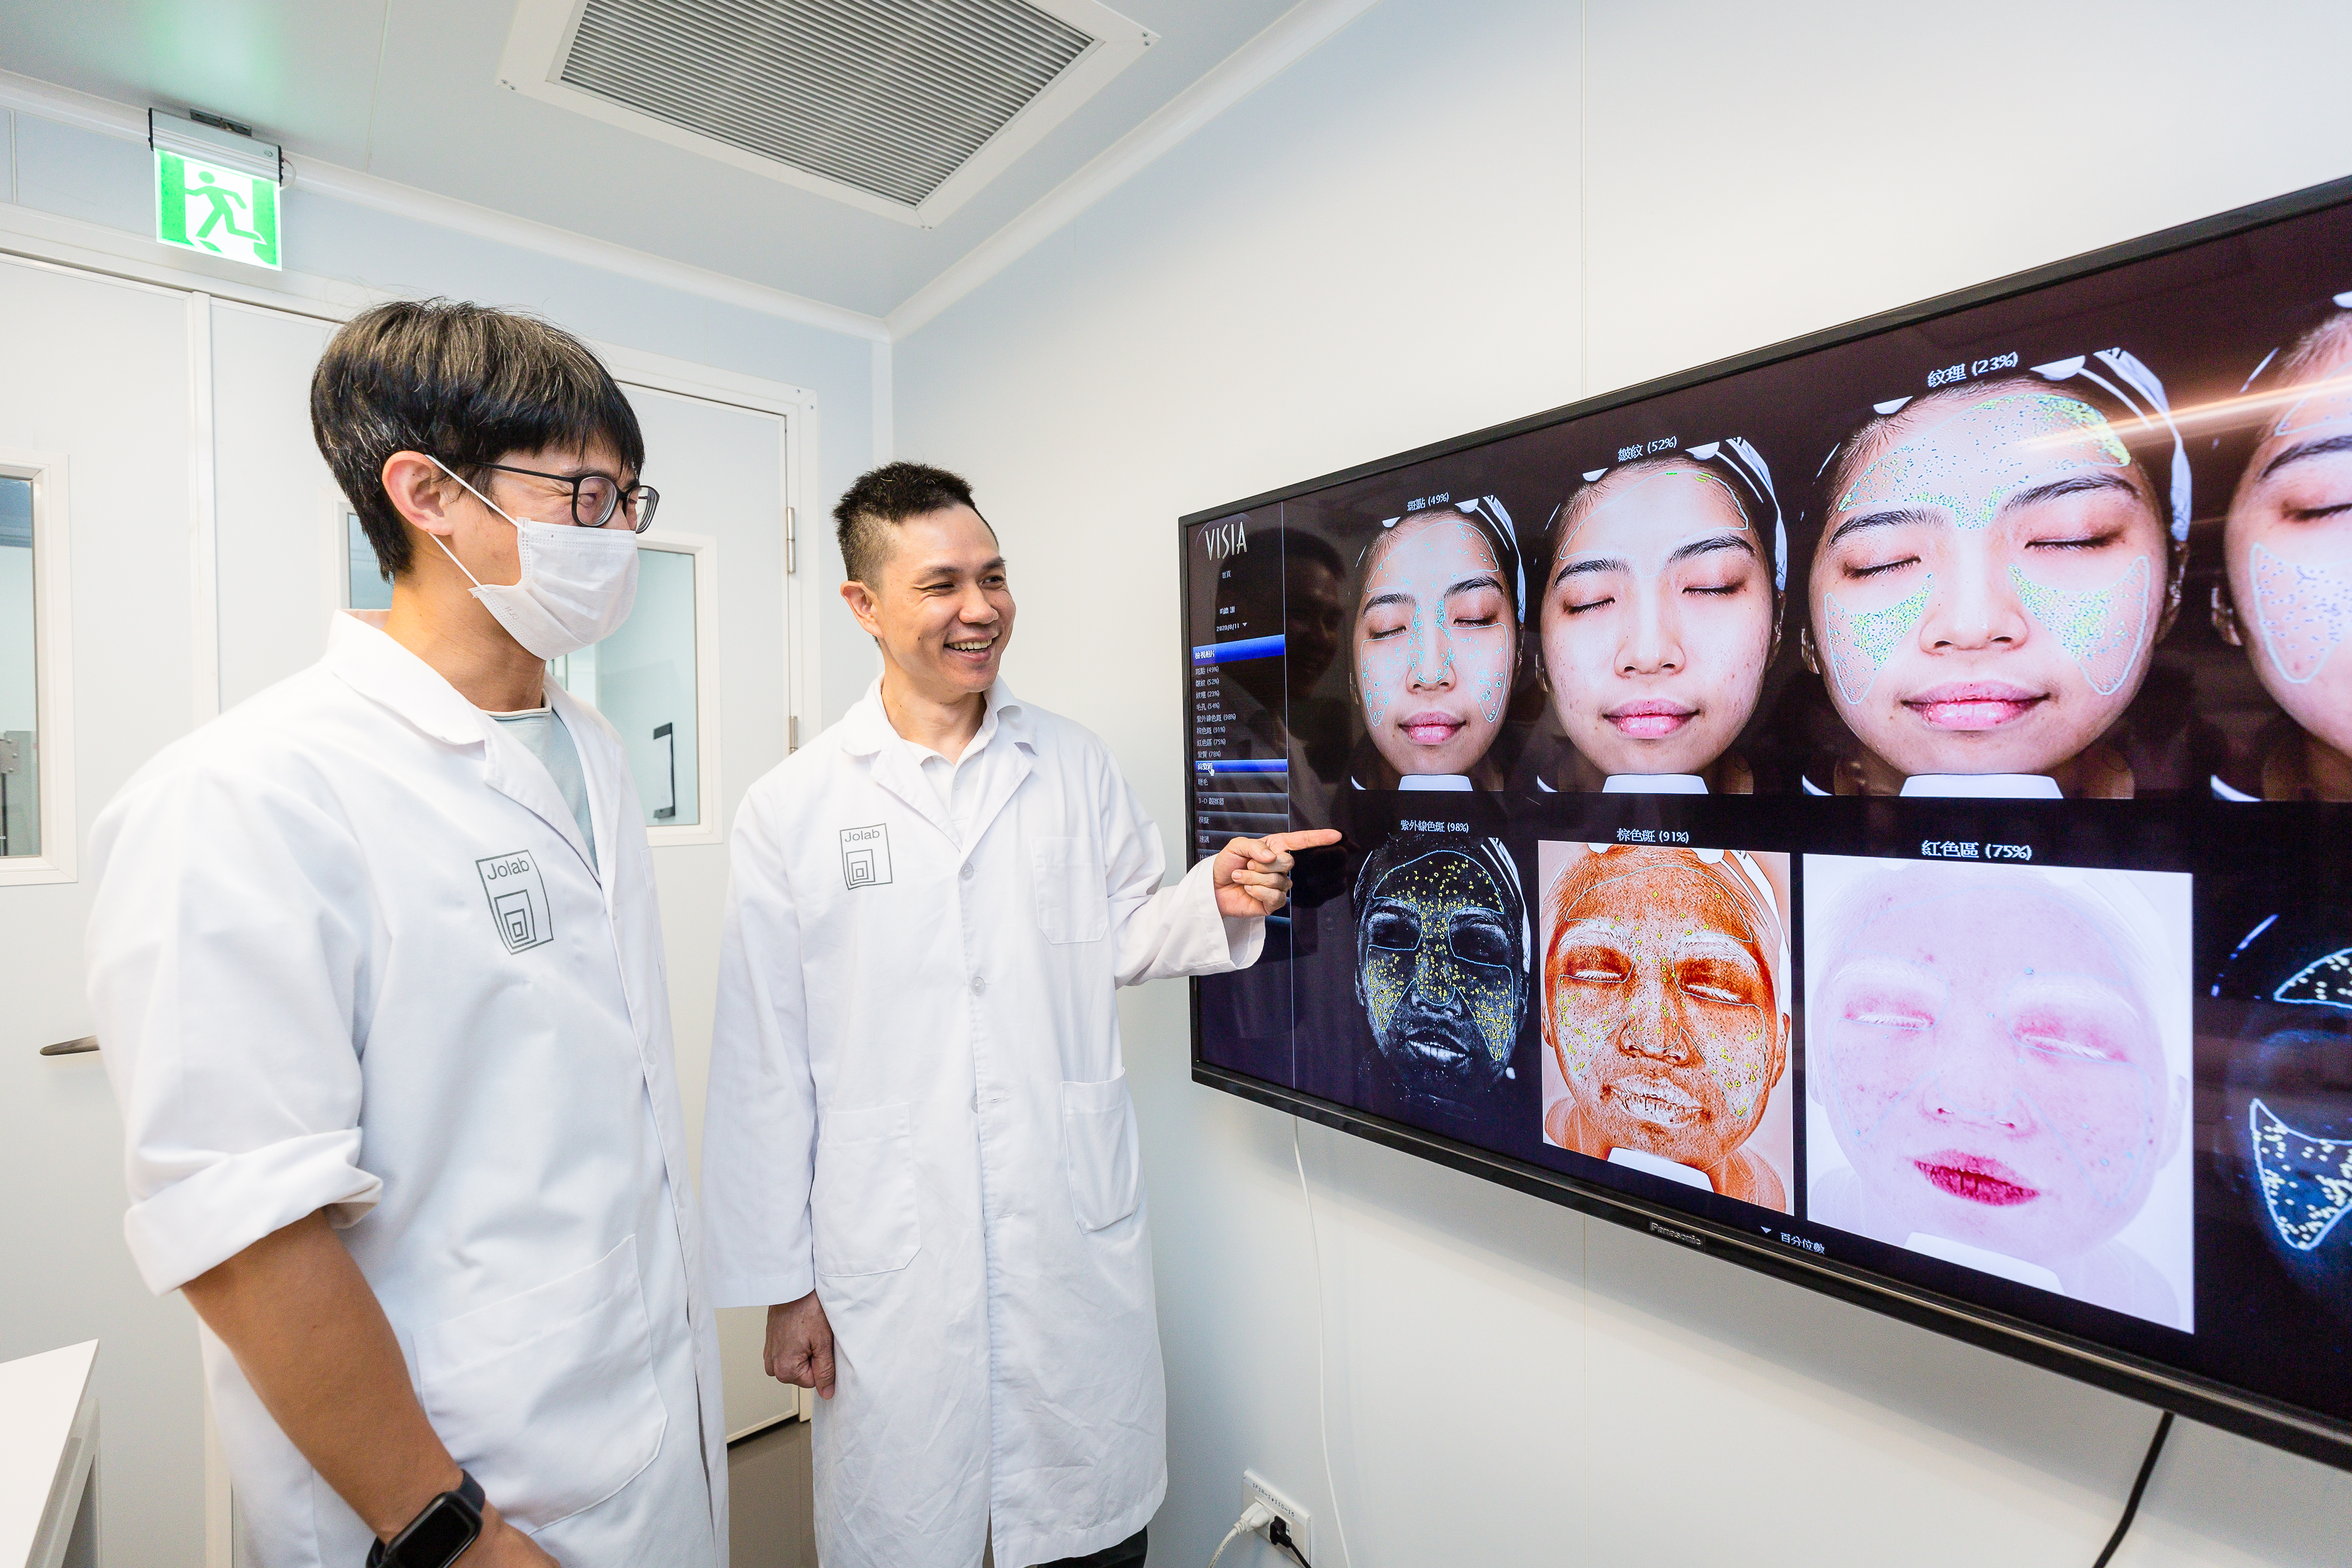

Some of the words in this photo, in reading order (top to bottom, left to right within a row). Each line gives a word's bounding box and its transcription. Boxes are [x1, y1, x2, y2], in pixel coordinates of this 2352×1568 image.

[1927, 363, 1967, 387] 紋理
[1971, 351, 2018, 376] (23%)
[1647, 435, 1677, 454] (52%)
[1407, 497, 1425, 511] 斑點
[1428, 492, 1449, 506] (49%)
[1205, 522, 1247, 560] VISIA
[1217, 623, 1239, 631] 2020/8/11
[1195, 650, 1214, 659] 檢視相片
[1197, 715, 1222, 723] 紫外線色斑
[845, 829, 880, 842] Jolab
[1401, 820, 1445, 832] 紫外線色斑
[1447, 822, 1469, 833] (98%)
[1617, 828, 1655, 842] 棕色斑
[1659, 831, 1689, 844] (91%)
[1922, 840, 1979, 858] 紅色區
[1985, 844, 2032, 861] (75%)
[488, 858, 529, 880] Jolab
[1650, 1222, 1701, 1245] Panasonic
[1780, 1232, 1825, 1254] 百分位數
